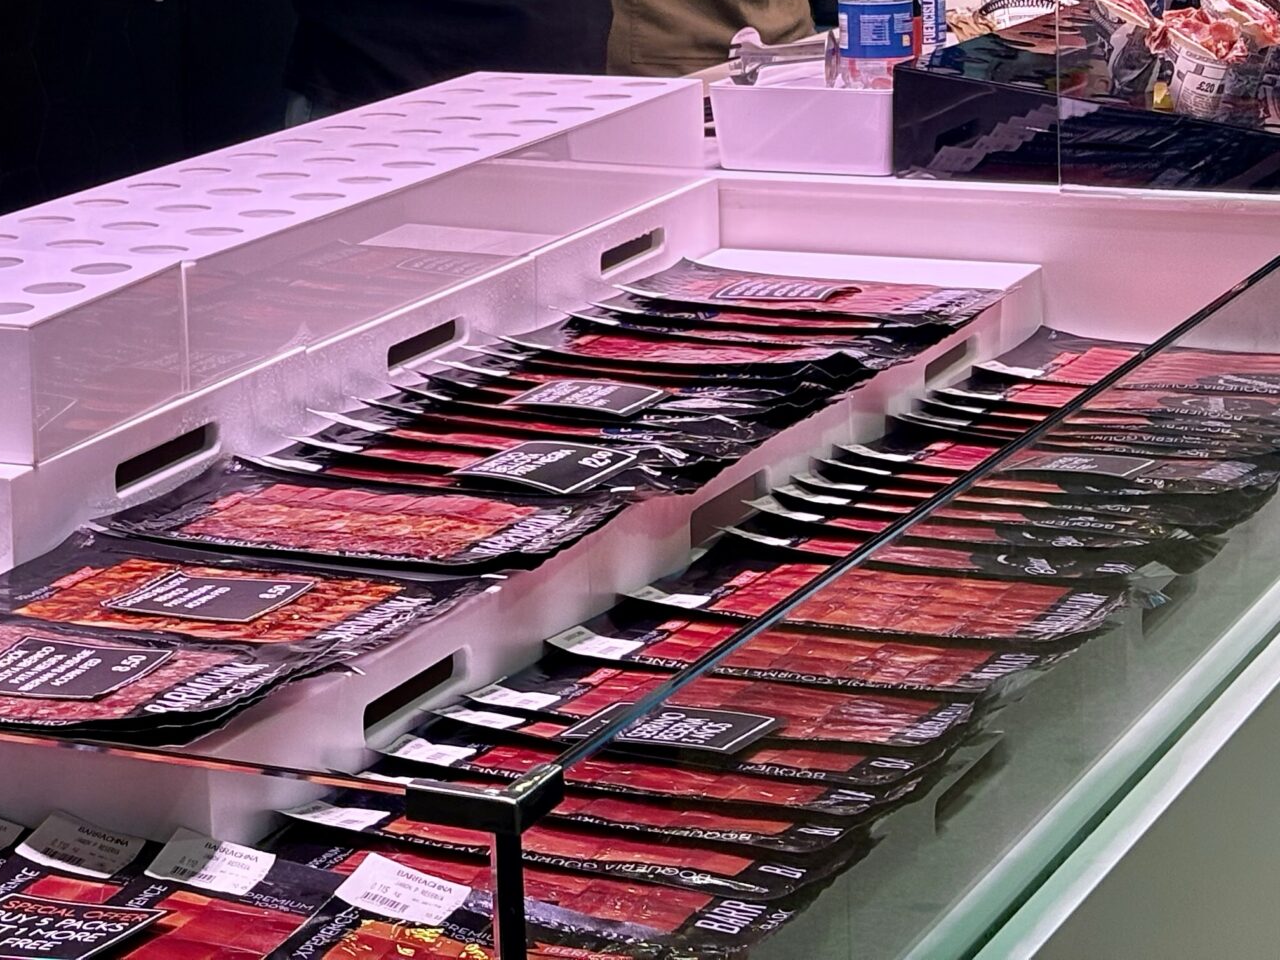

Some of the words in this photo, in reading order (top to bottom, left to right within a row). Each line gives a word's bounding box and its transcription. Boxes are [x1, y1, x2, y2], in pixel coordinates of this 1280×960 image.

[1197, 80, 1214, 92] £20
[535, 449, 576, 466] NEGRA
[259, 584, 291, 601] 8,50
[32, 653, 67, 673] NEGRA
[82, 657, 103, 671] FED
[111, 654, 147, 674] 8,50
[626, 712, 686, 738] SERRANO
[652, 717, 710, 740] RESERVA
[78, 826, 128, 847] BARRACHINA
[205, 842, 258, 862] BARRACHINA
[522, 853, 598, 870] GOURM
[397, 870, 452, 894] BARRACHINA
[2, 899, 76, 918] SPECIAL
[83, 910, 150, 923] OFFER
[244, 892, 314, 911] PREMIUM
[255, 901, 290, 912] 100%
[36, 917, 52, 926] 5
[55, 918, 129, 932] PACKS
[292, 908, 361, 960] XPERIENCE
[441, 921, 494, 940] PREMIU
[1, 937, 61, 951] FREE
[15, 927, 27, 936] 1
[28, 928, 106, 943] MORE
